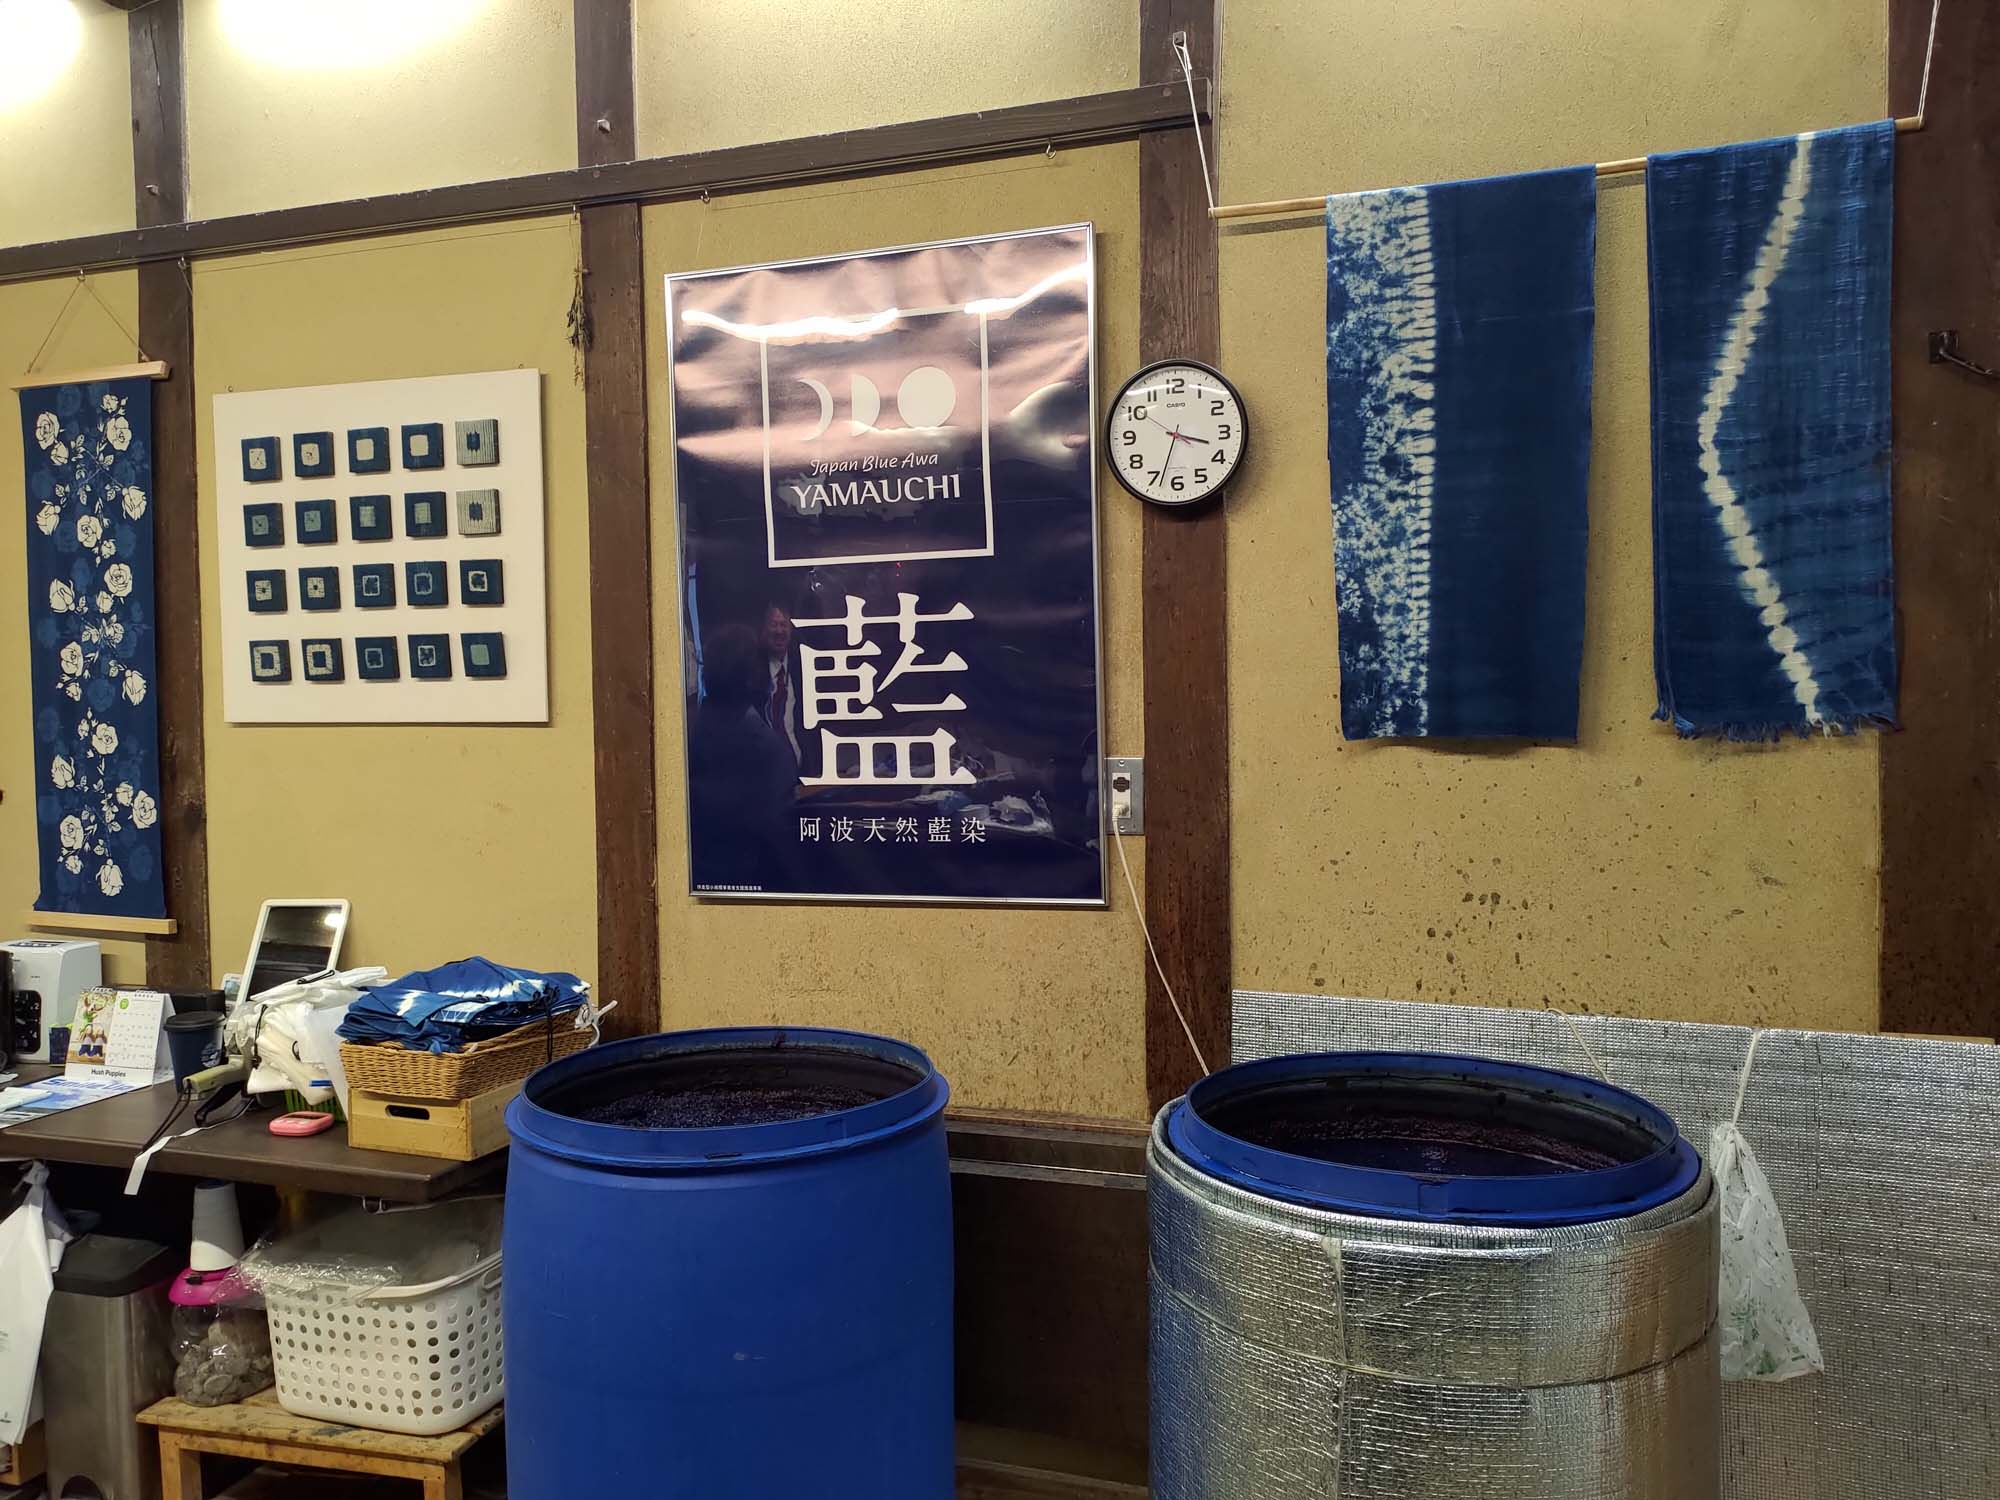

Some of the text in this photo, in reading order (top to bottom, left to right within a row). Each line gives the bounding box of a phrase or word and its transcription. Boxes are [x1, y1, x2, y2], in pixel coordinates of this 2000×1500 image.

[1166, 378, 1185, 394] 12
[1147, 388, 1158, 402] 11
[1127, 405, 1148, 421] 10
[1210, 400, 1225, 416] 2
[1122, 430, 1137, 446] 9
[1218, 424, 1231, 440] 3
[810, 452, 938, 476] Japan Blue Awa
[1129, 454, 1143, 469] 8
[1211, 449, 1226, 465] 4
[1147, 471, 1160, 486] 7
[1170, 476, 1184, 491] 6
[1194, 468, 1208, 484] 5
[790, 473, 961, 509] YAMAUCHI
[790, 592, 977, 786] 藍
[799, 816, 986, 843] 阿波天然藍染
[91, 1068, 127, 1078] Hush Puppies
